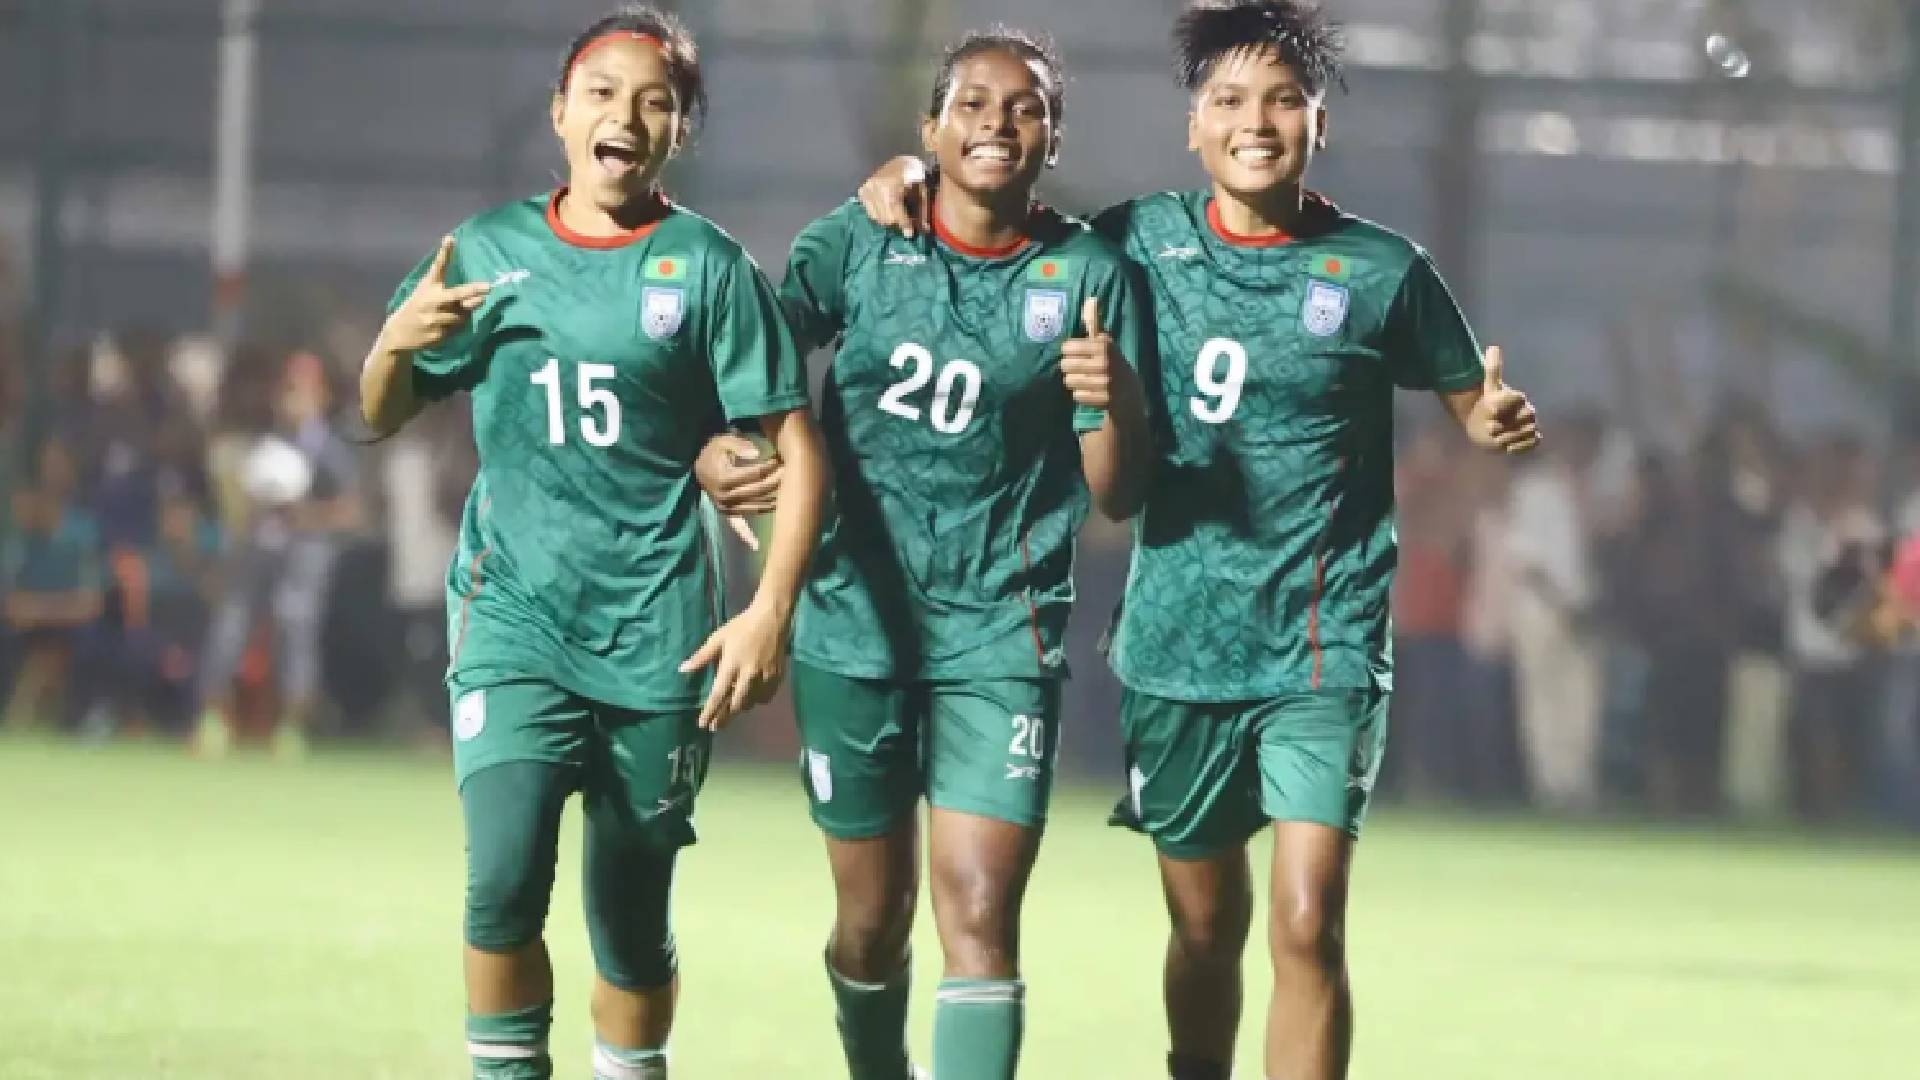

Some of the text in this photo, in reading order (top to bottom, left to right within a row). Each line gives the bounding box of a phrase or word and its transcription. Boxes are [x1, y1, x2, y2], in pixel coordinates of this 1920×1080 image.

[530, 358, 622, 447] 15
[878, 342, 981, 433] 20
[1191, 337, 1248, 424] 9
[1009, 714, 1044, 760] 20
